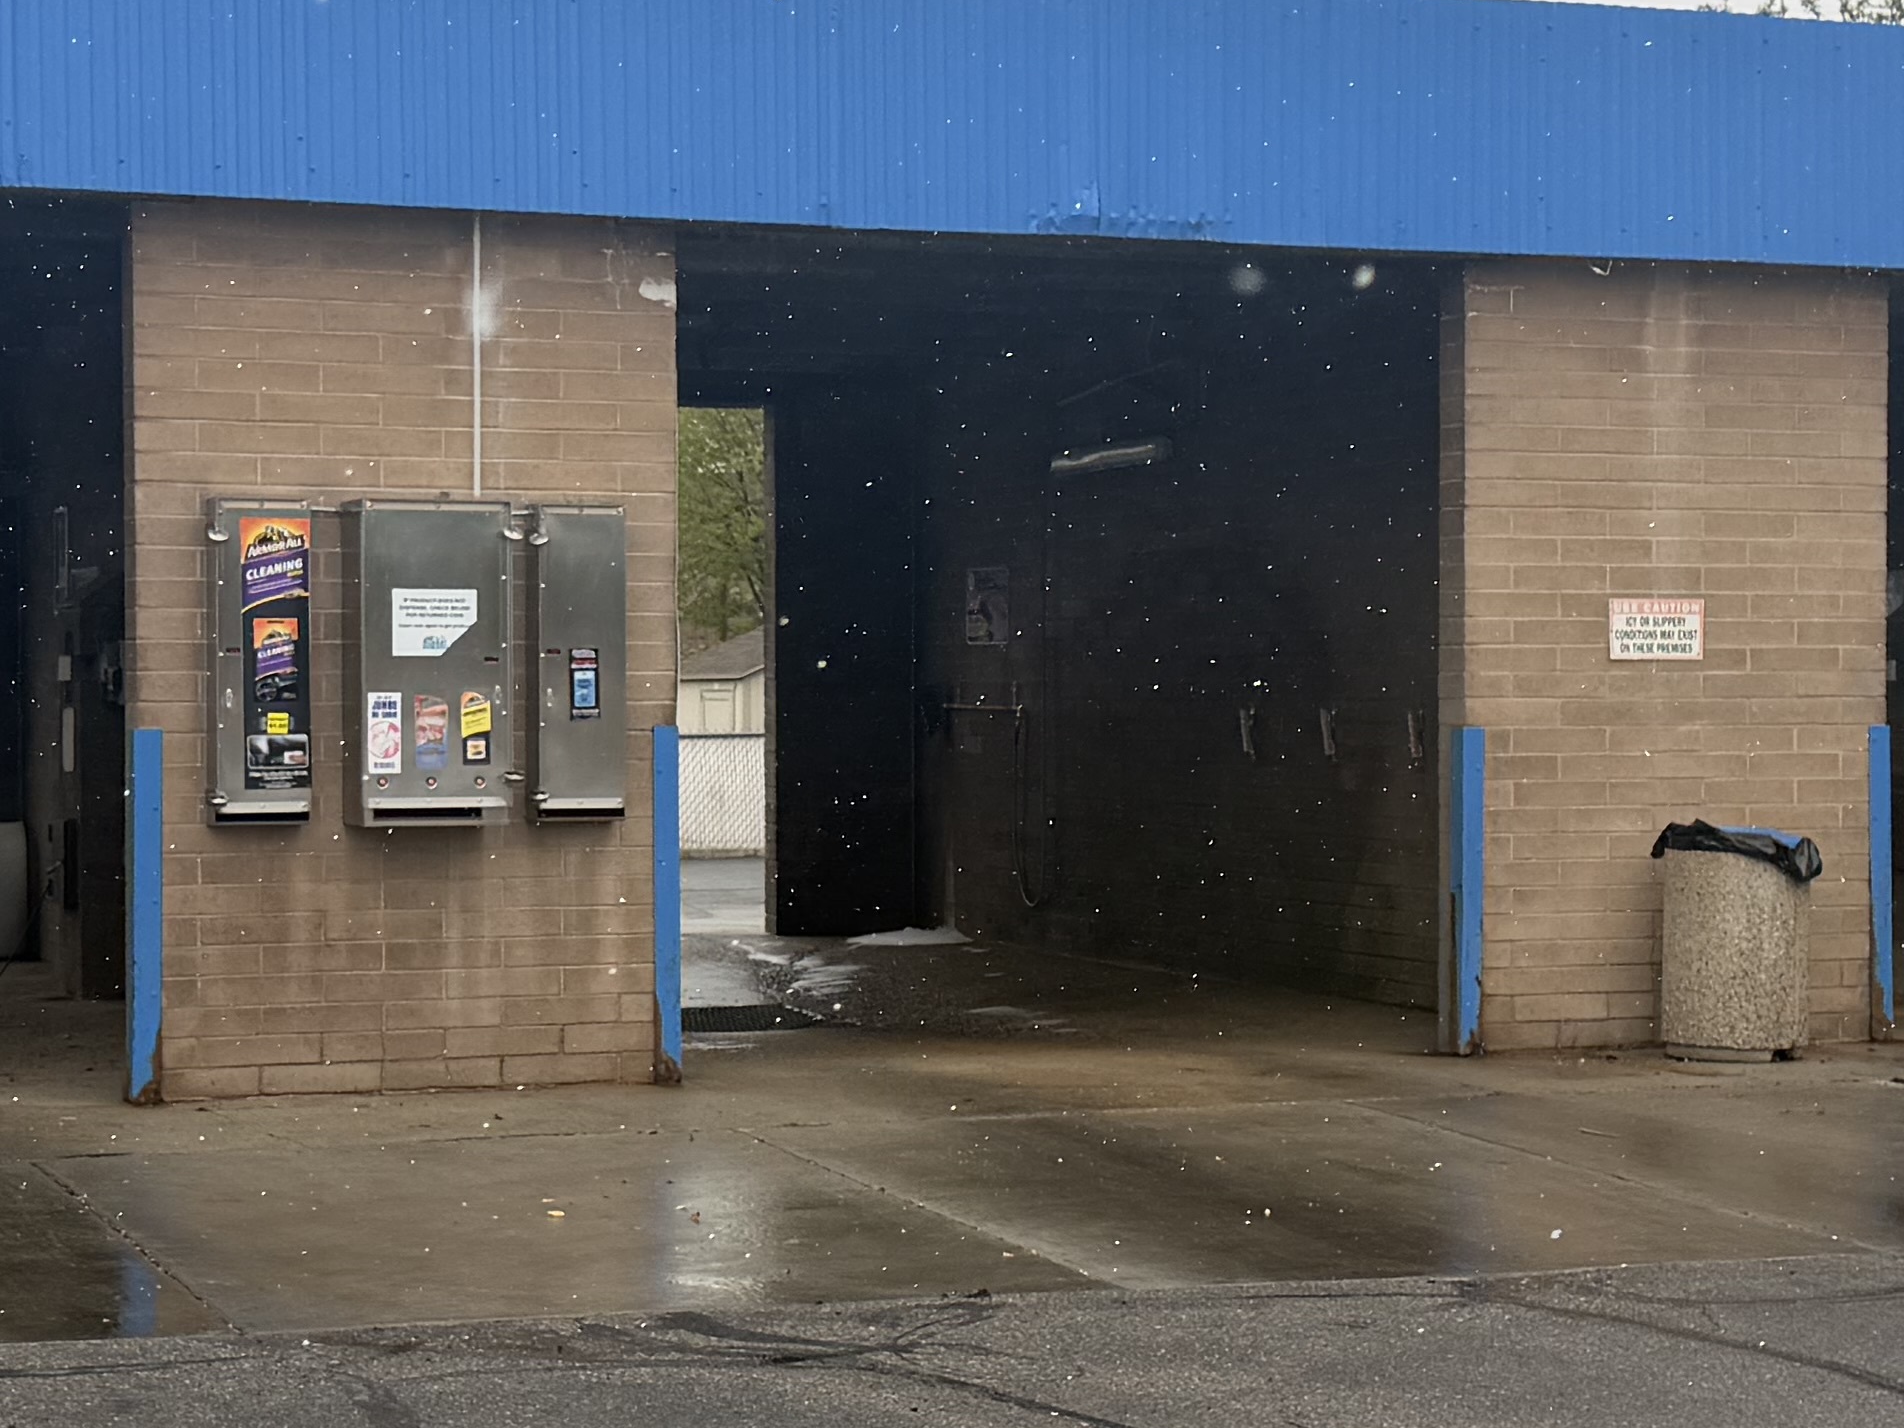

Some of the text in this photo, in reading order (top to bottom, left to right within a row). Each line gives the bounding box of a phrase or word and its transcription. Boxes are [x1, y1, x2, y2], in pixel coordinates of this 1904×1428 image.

[245, 557, 304, 581] CLEANING
[1643, 602, 1700, 614] CAUTION
[1625, 615, 1686, 628] ICY OR SLIPPERY
[1614, 629, 1698, 641] CONDITIONS MAY EXIST
[1619, 642, 1693, 654] ON THESE PREMISES
